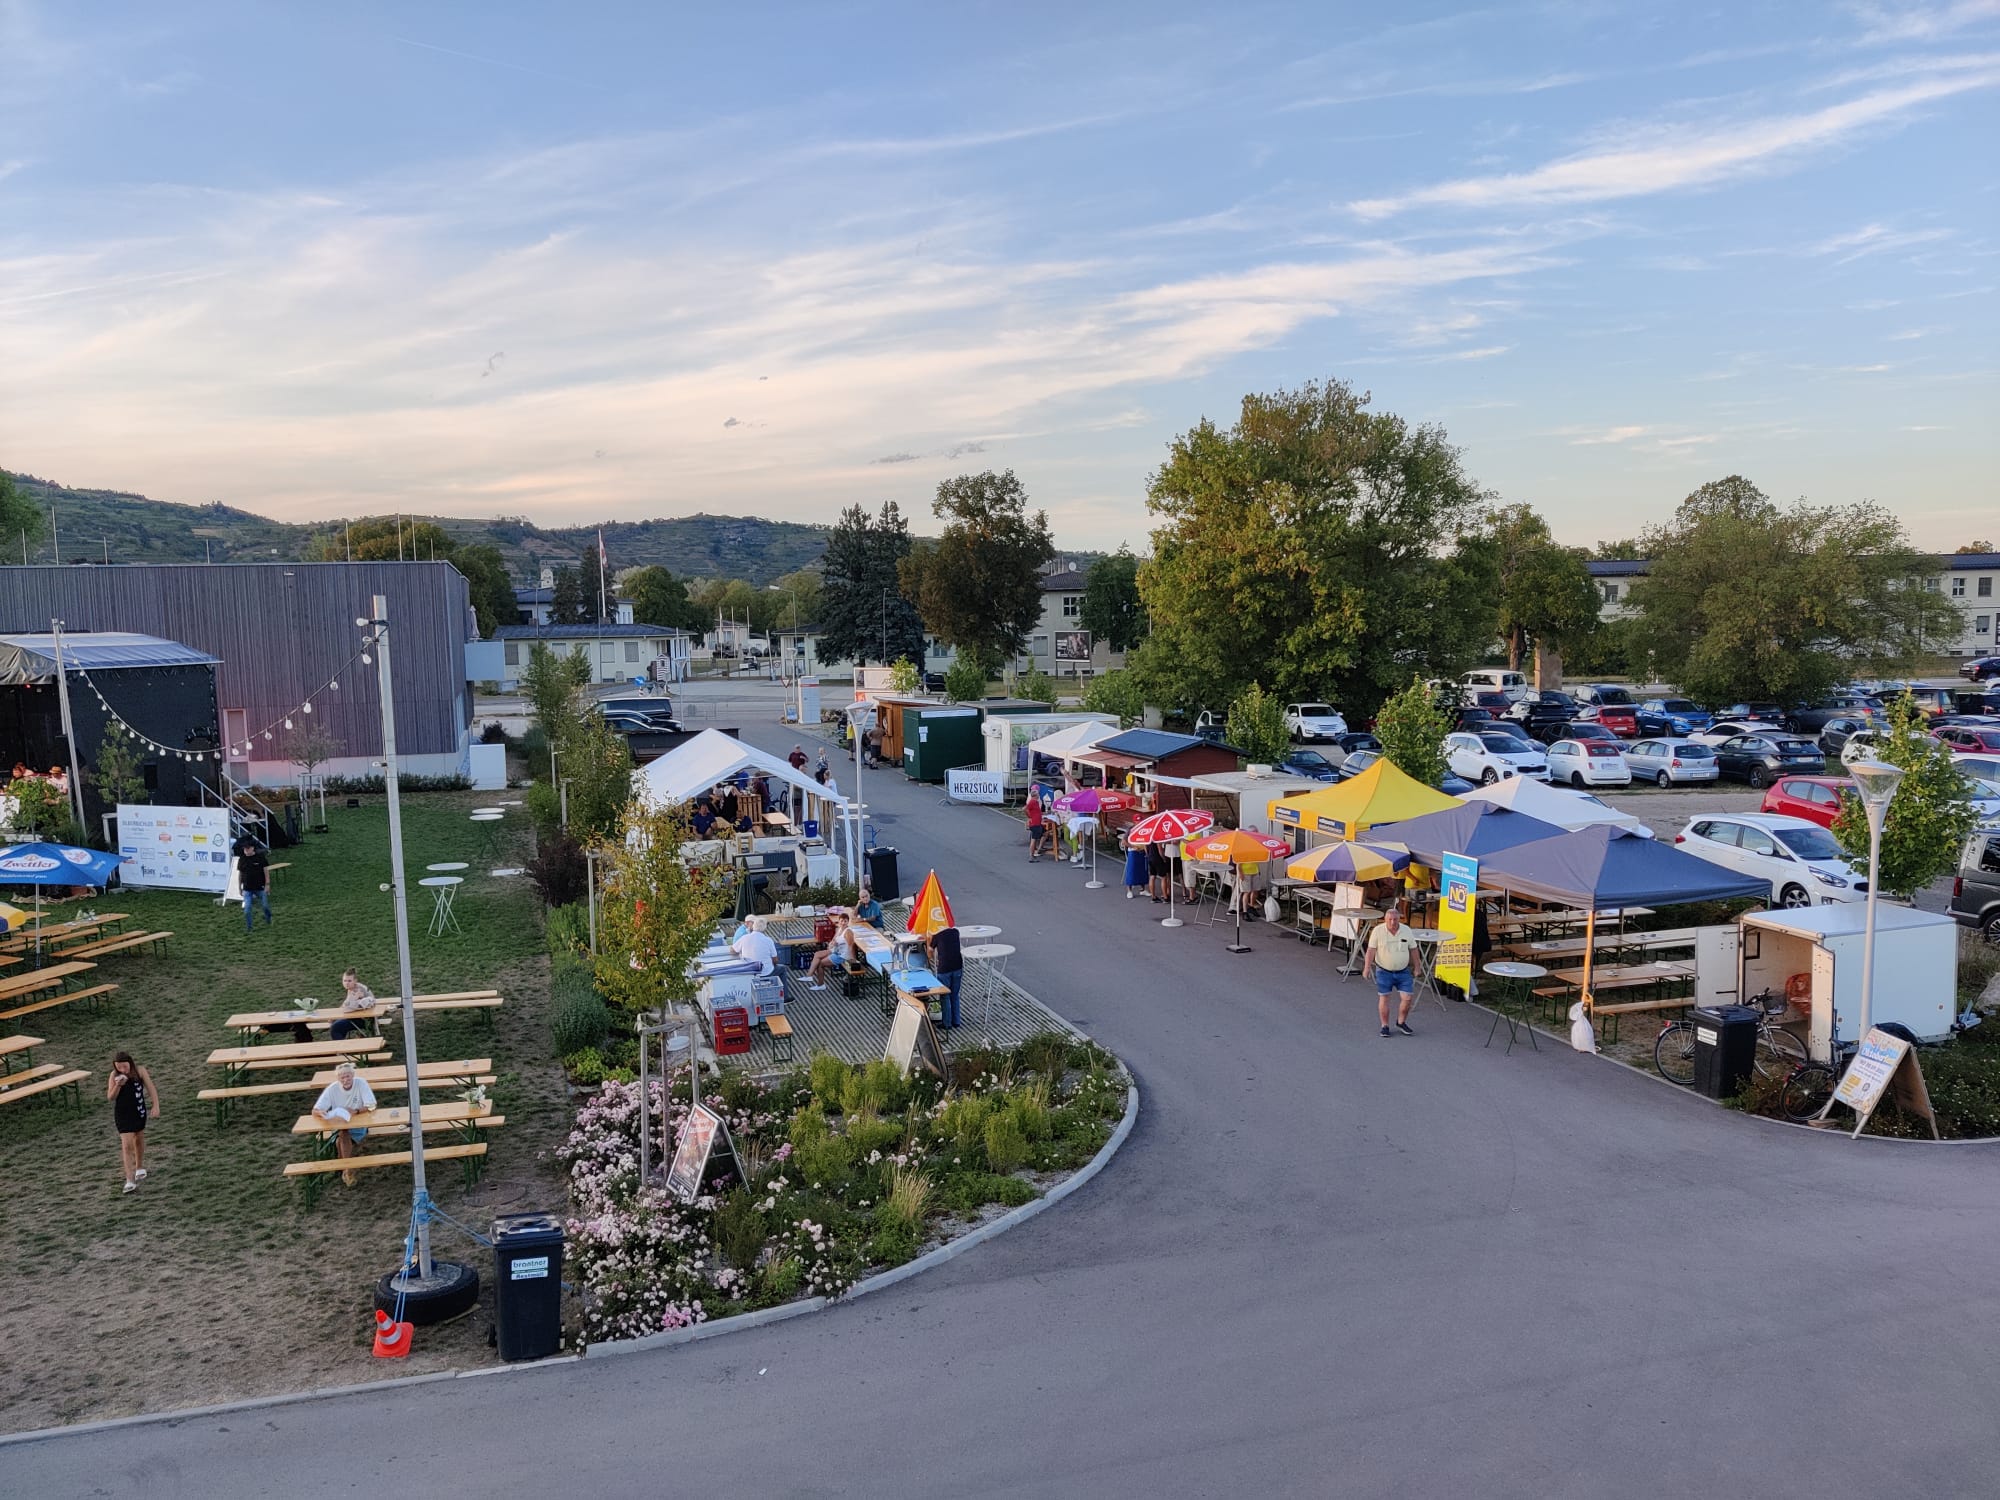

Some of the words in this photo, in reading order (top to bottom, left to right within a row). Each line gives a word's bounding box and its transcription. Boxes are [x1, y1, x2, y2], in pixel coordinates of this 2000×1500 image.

[954, 782, 998, 794] HERZSTÜCK
[3, 860, 55, 869] Zwettler
[513, 1260, 546, 1268] brantner
